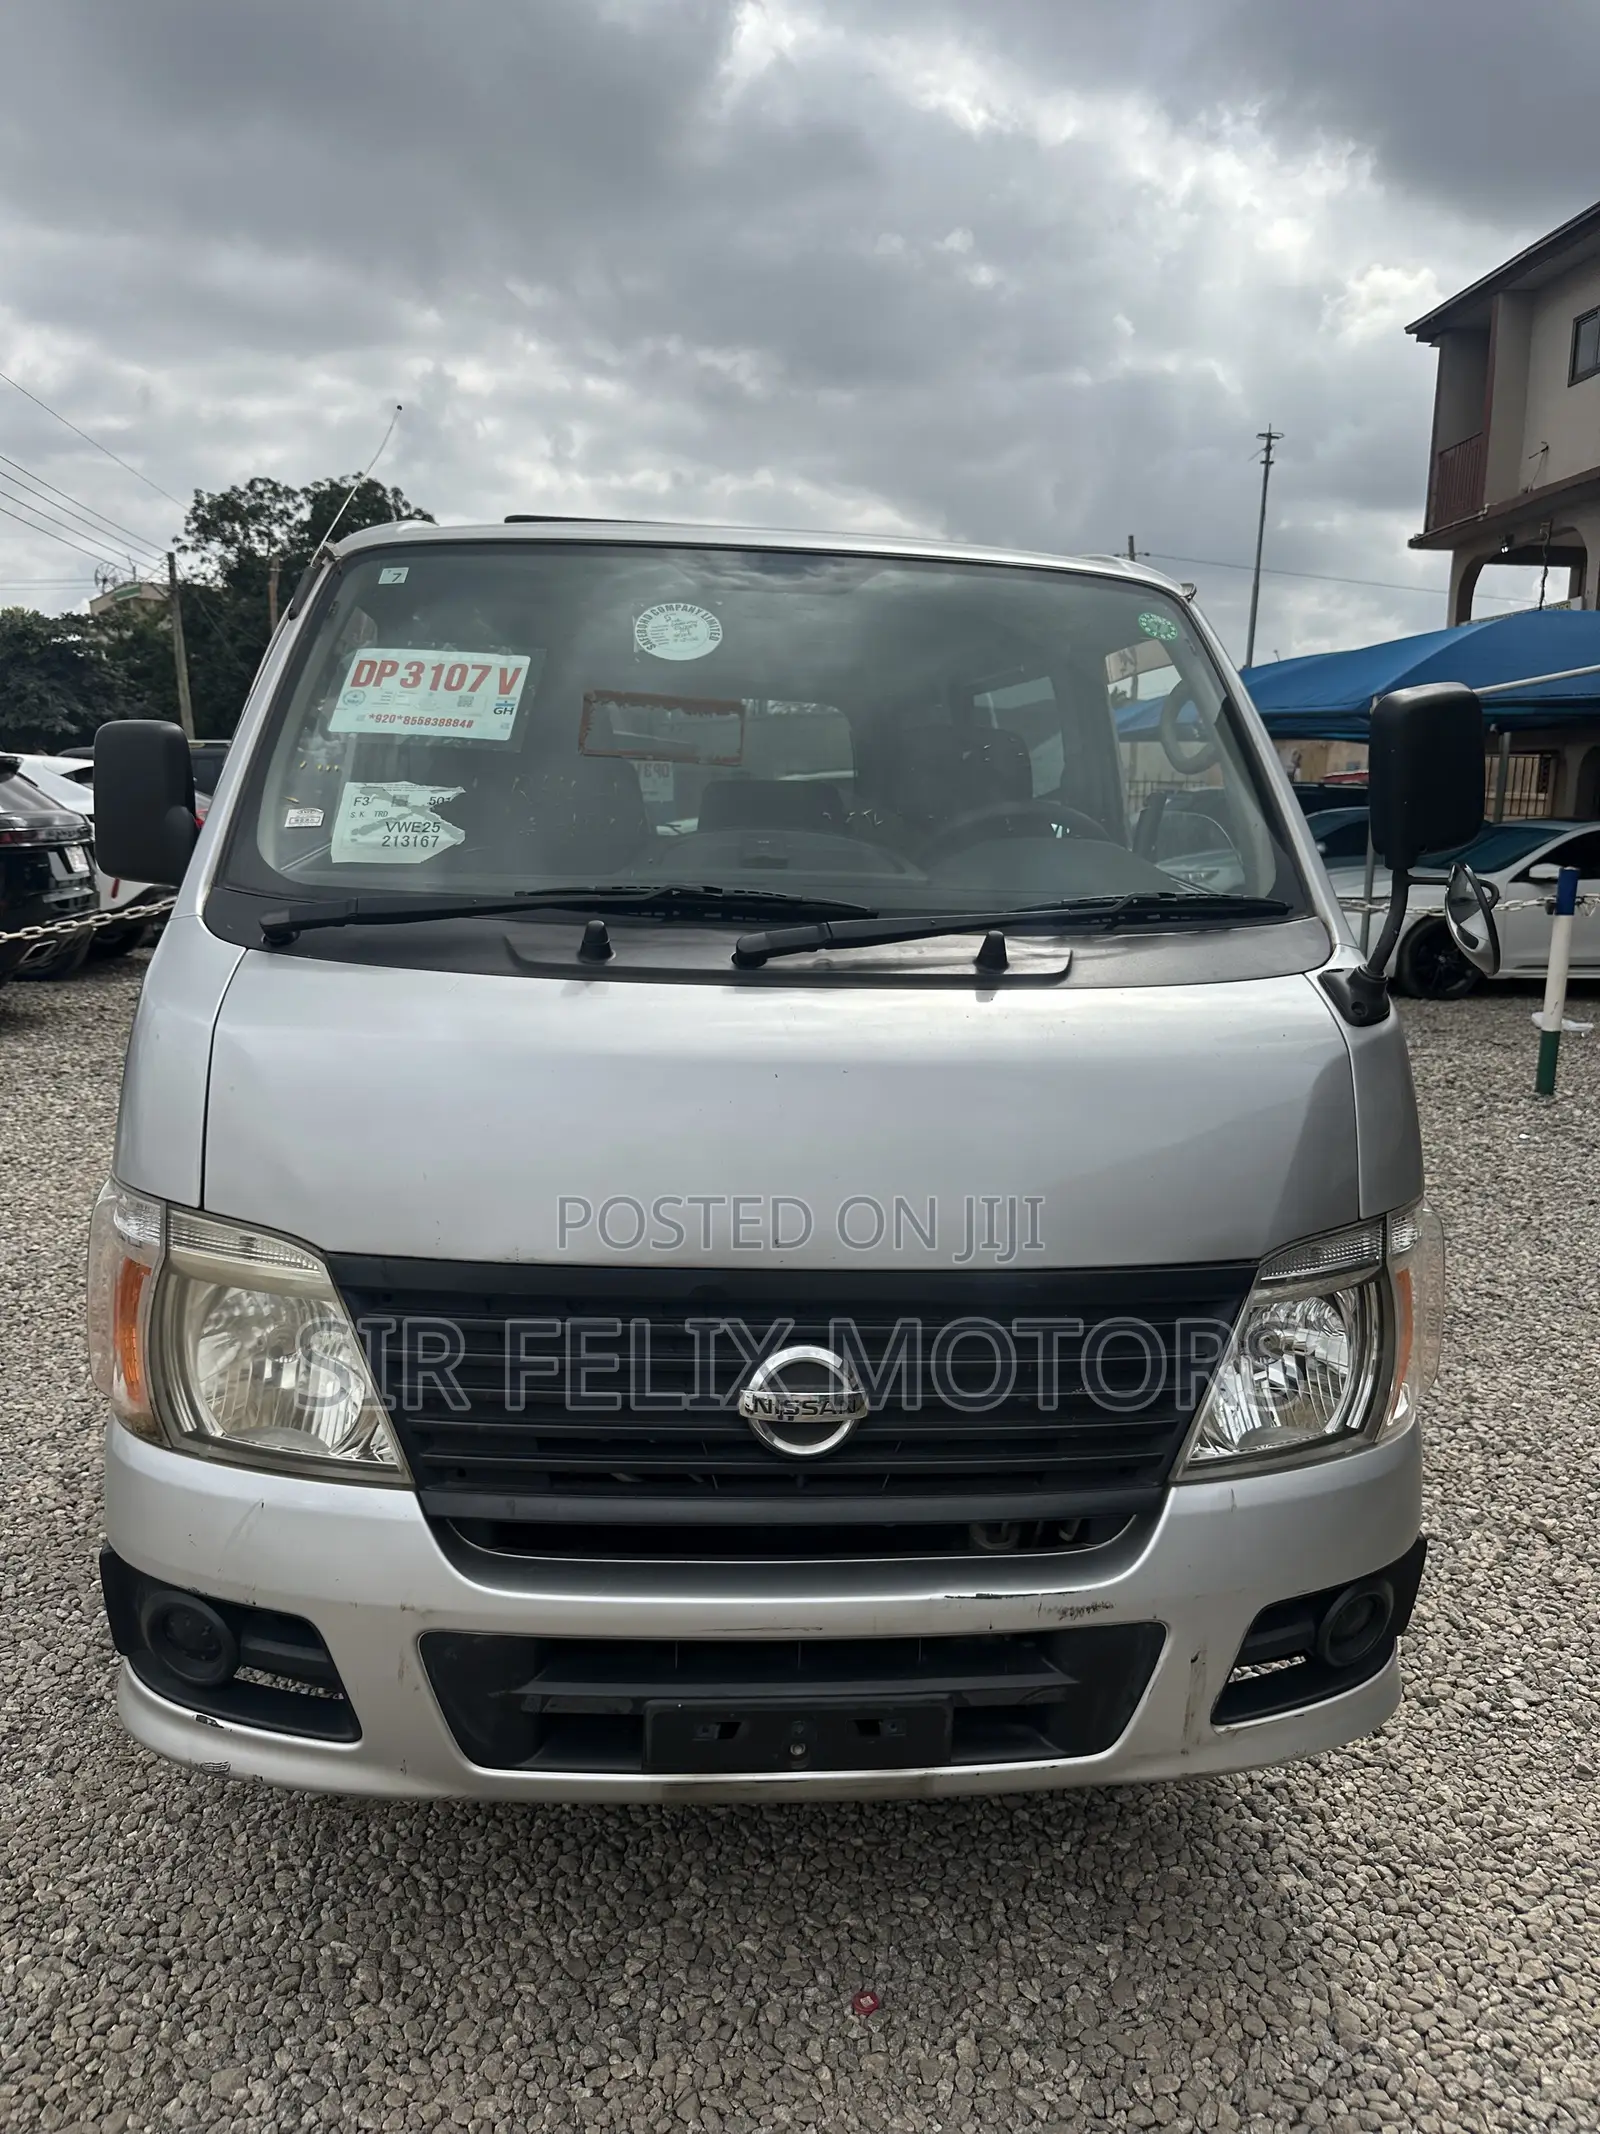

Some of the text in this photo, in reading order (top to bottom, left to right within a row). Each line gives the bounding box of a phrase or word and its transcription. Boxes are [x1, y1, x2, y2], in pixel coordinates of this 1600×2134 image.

[392, 573, 402, 582] 7
[650, 604, 702, 616] COMPANY
[701, 612, 721, 642] LIMITED
[350, 660, 523, 695] DP 3107 V
[493, 707, 515, 715] GH
[386, 822, 440, 833] VWE25
[382, 836, 440, 848] 213167
[753, 1394, 856, 1416] NISSAN
